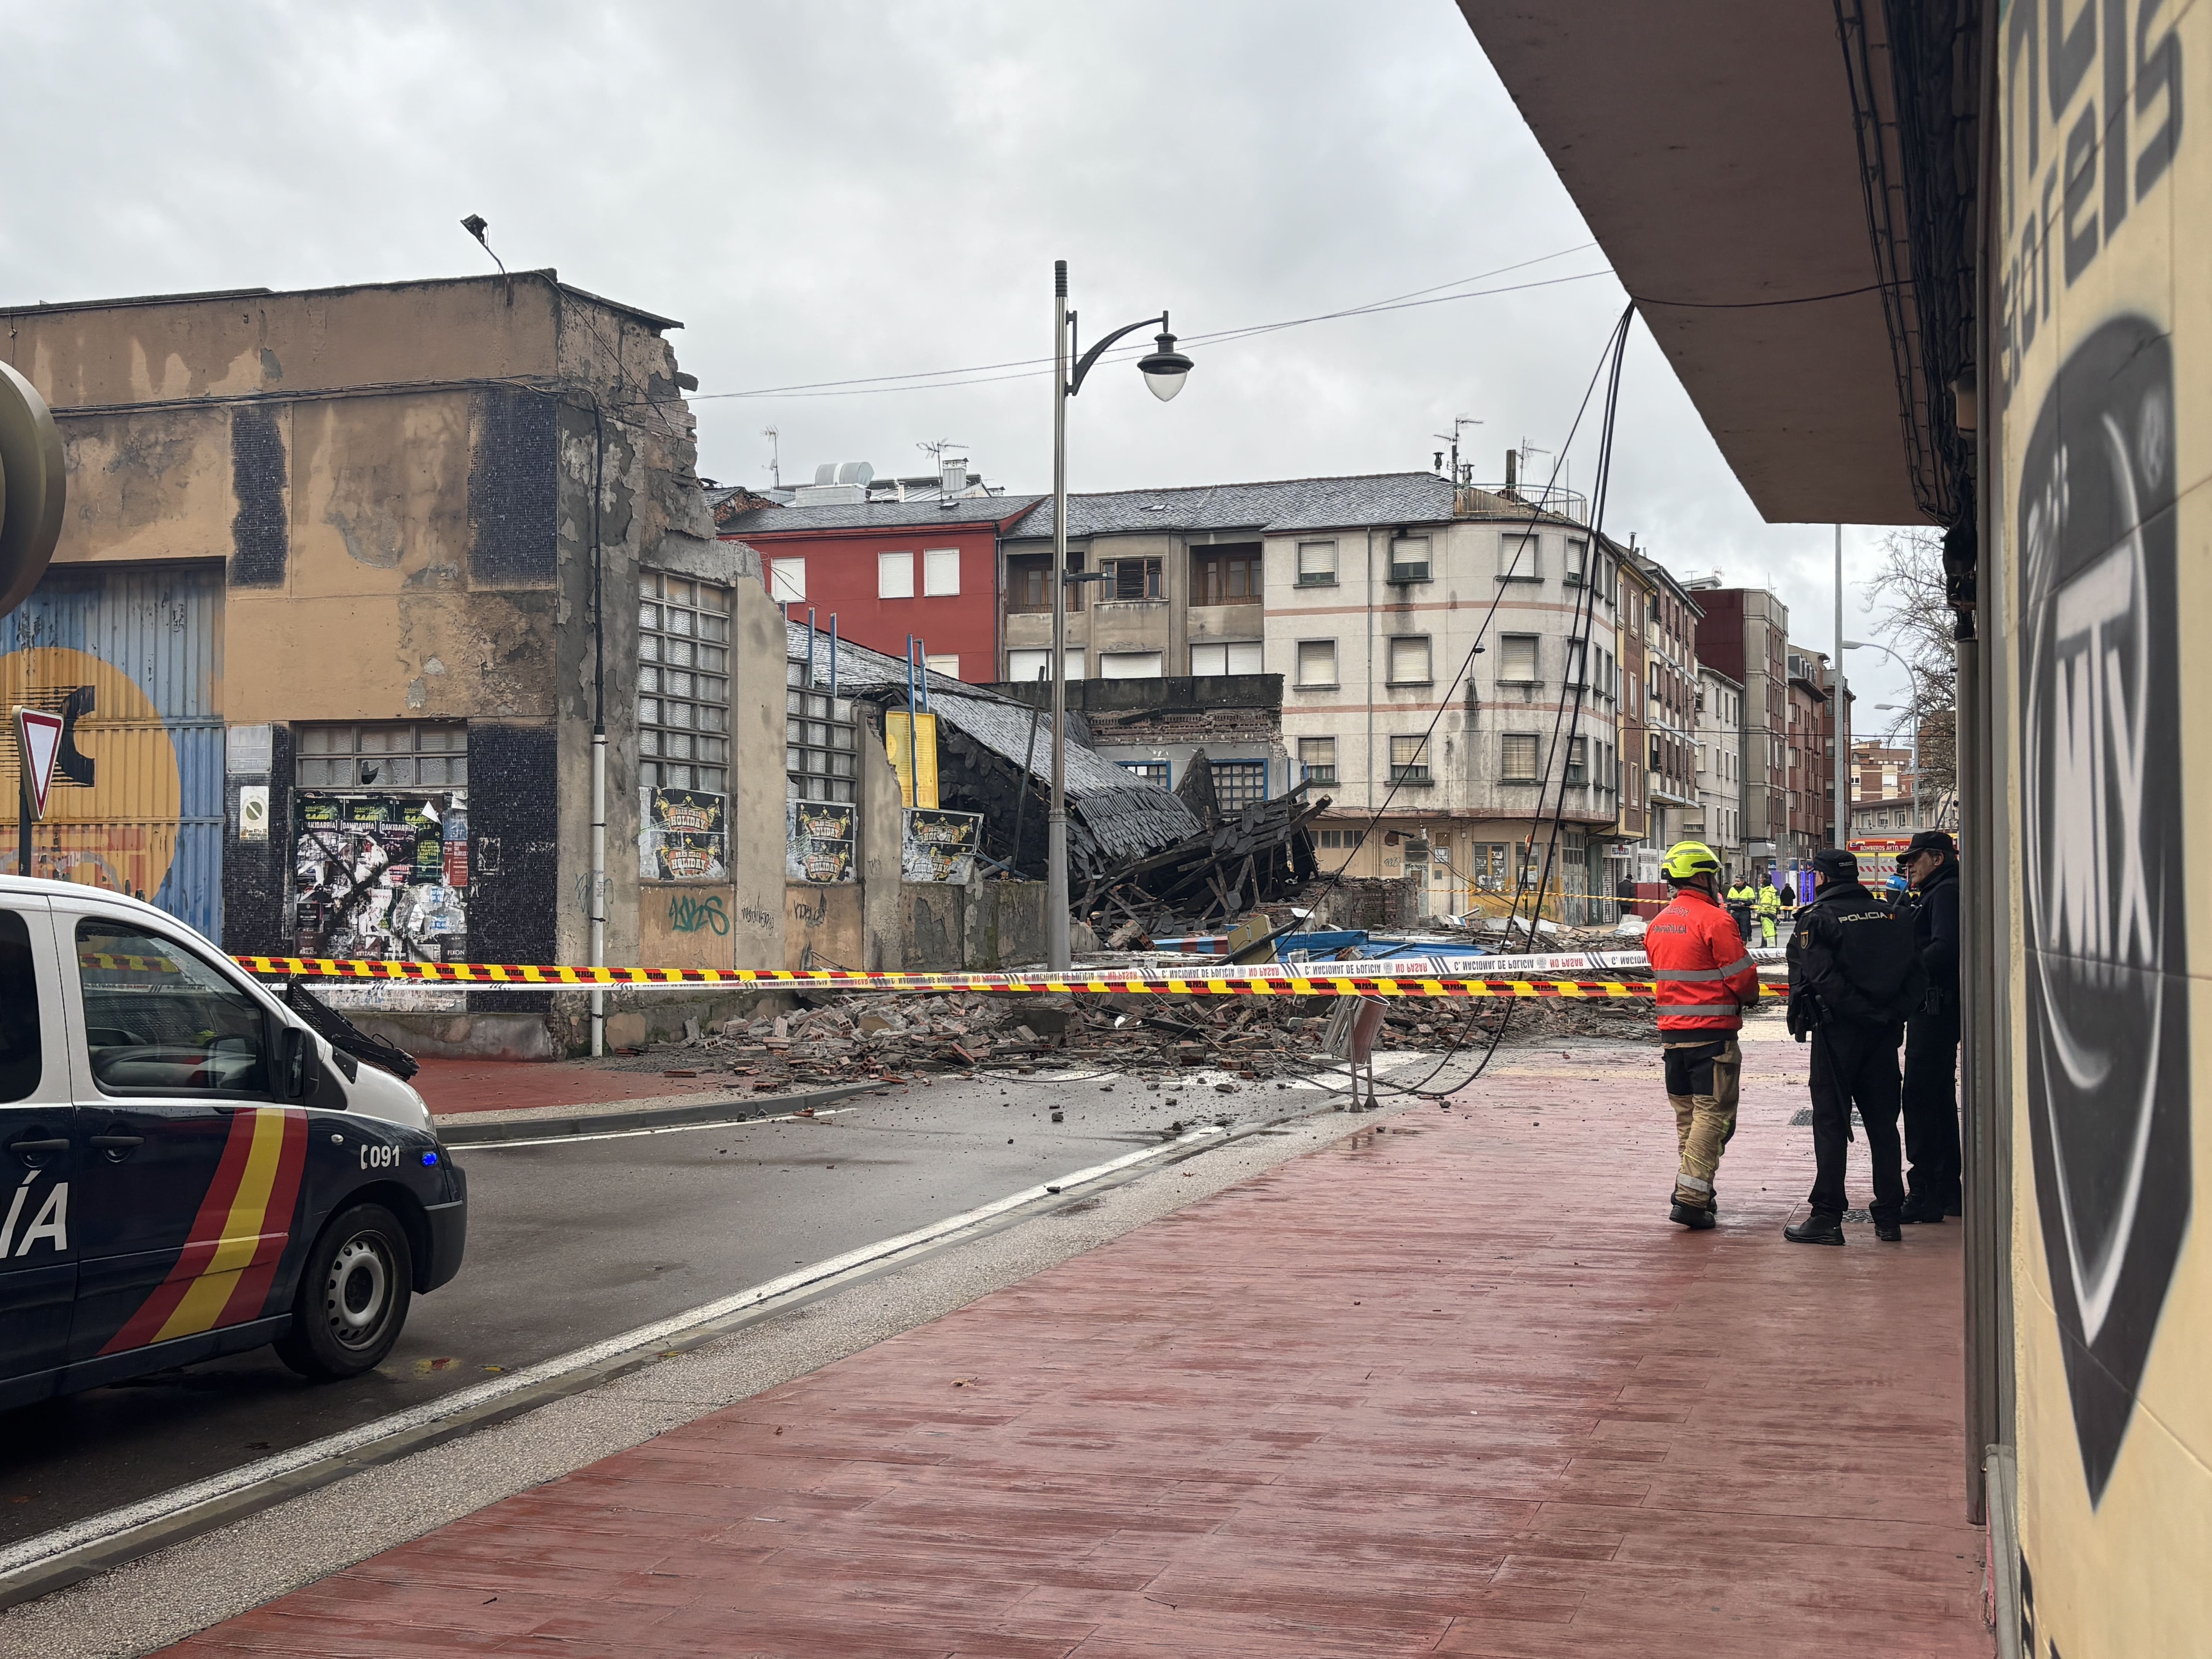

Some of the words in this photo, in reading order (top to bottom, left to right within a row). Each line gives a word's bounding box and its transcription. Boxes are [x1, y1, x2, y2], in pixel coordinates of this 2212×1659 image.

[671, 815, 706, 829] HOLIDAY
[671, 858, 706, 871] HOLIDAY
[810, 862, 838, 873] HOLIDAY
[1838, 912, 1888, 924] POLICIA
[370, 1145, 400, 1168] 091
